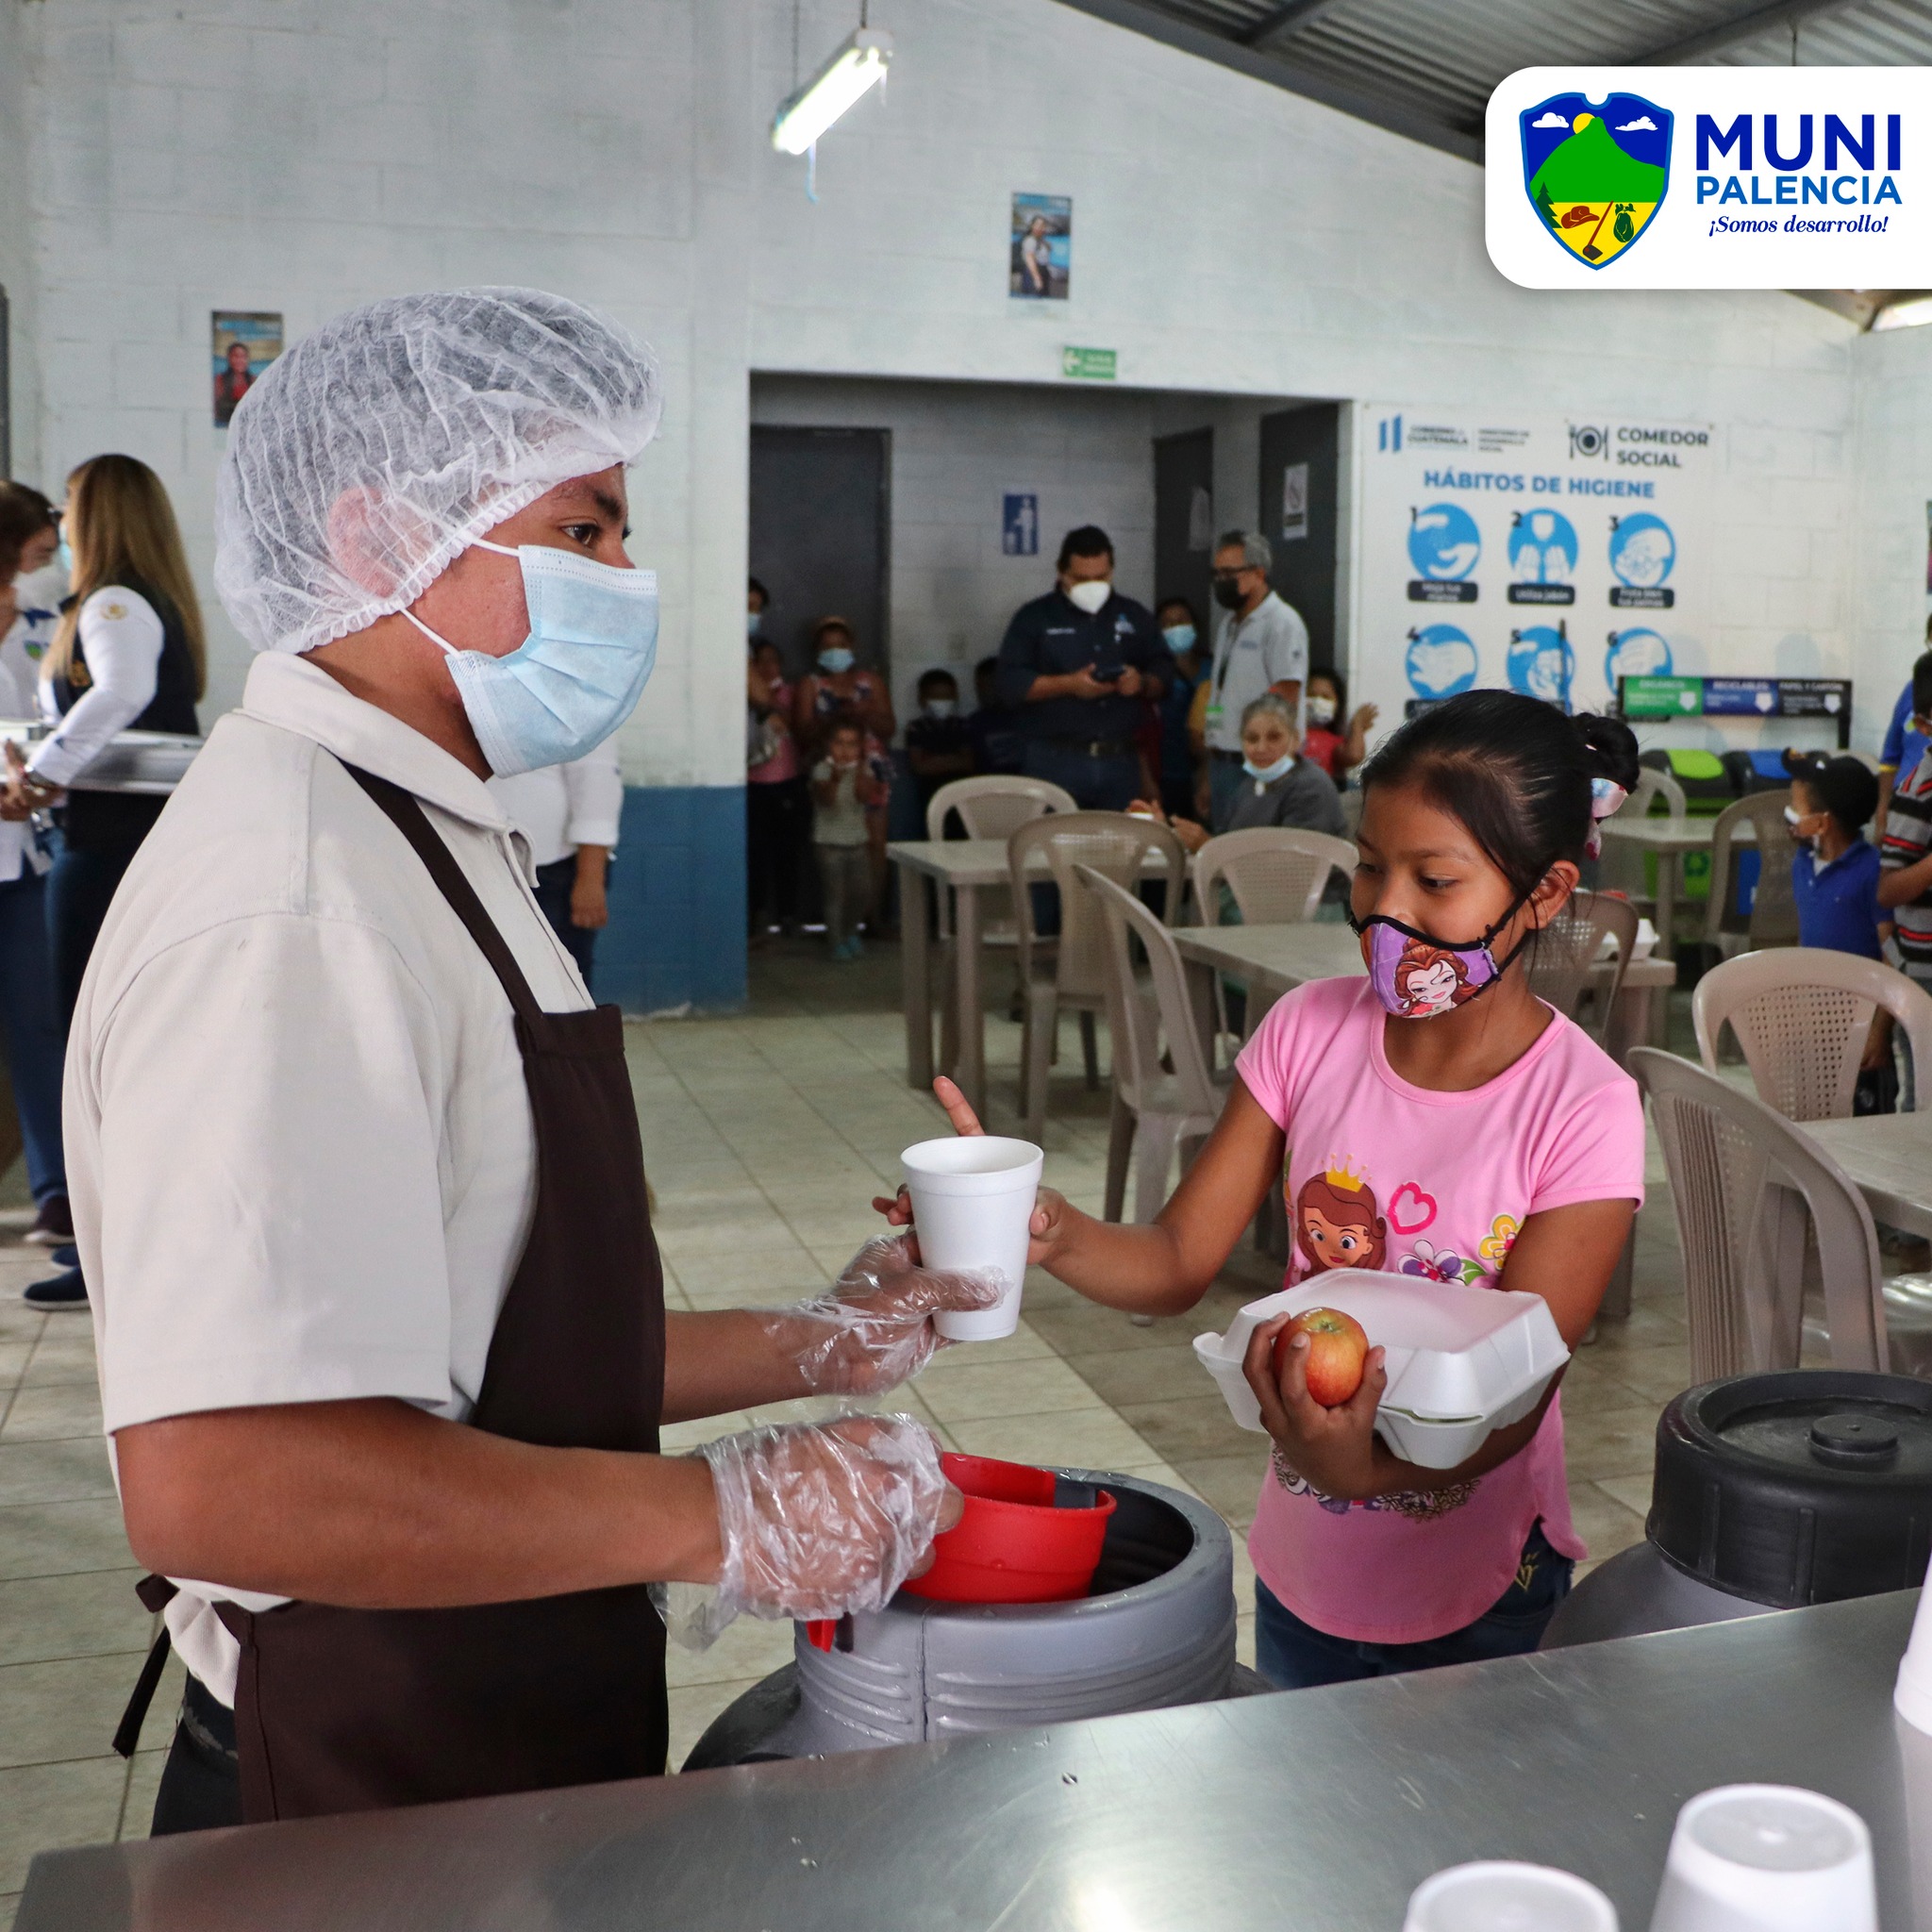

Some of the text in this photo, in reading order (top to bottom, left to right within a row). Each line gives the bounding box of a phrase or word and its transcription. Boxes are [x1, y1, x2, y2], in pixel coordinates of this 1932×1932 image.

[1617, 427, 1708, 446] COMEDOR
[1617, 450, 1681, 468] SOCIAL
[1424, 466, 1655, 499] HÁBITOS DE HIGIENE
[1410, 507, 1418, 522] 1
[1511, 511, 1523, 527] 2
[1608, 516, 1620, 531] 3
[1407, 626, 1420, 642] 4
[1511, 629, 1522, 644] 5
[1607, 631, 1618, 647] 6
